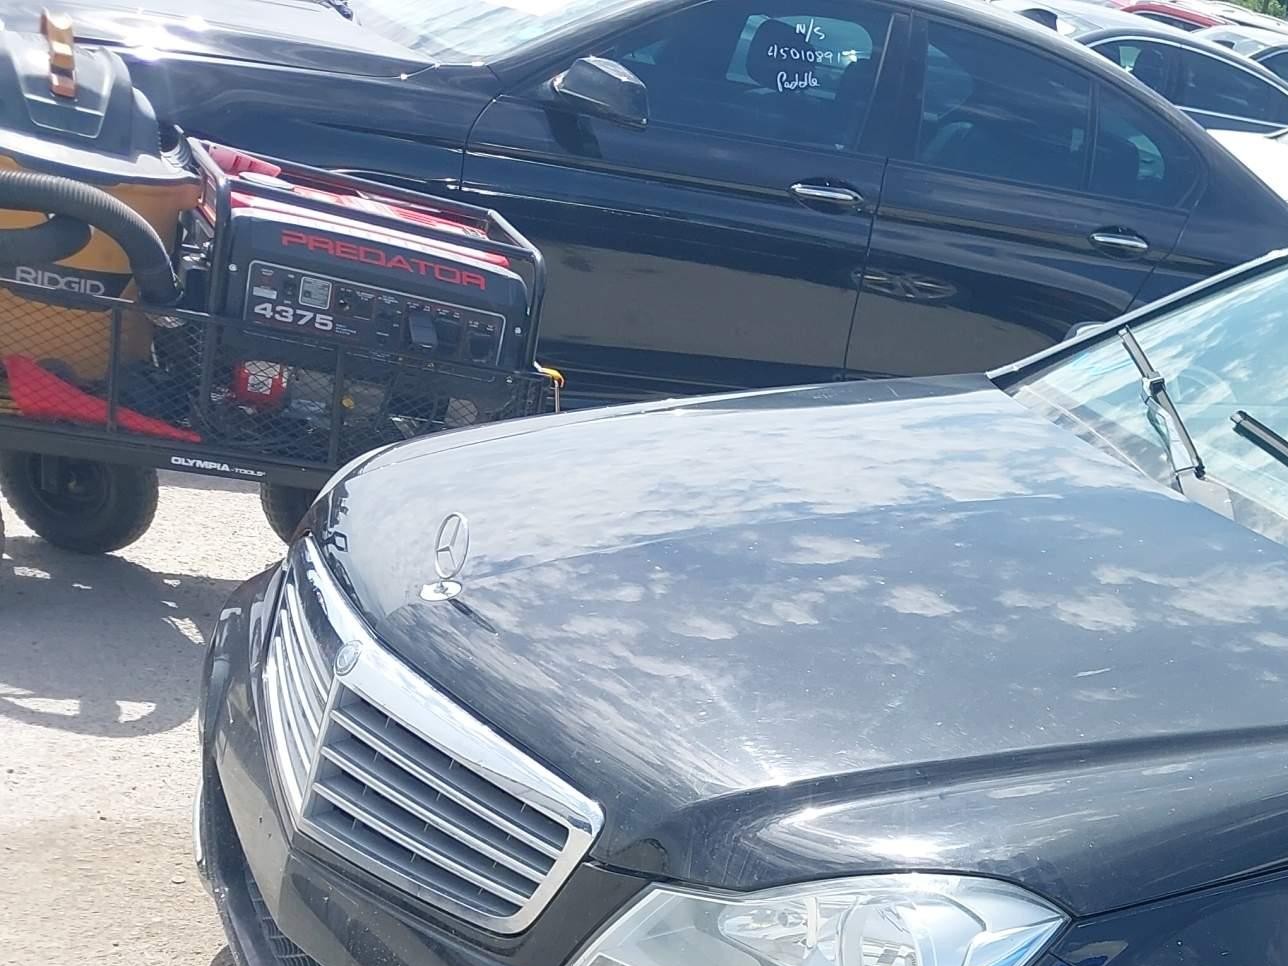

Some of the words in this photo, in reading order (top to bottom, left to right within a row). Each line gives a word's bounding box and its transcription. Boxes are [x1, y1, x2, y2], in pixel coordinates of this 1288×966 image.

[795, 18, 825, 42] N/S
[281, 230, 486, 290] PREDATOR
[16, 266, 105, 295] RIDGID
[254, 302, 334, 331] 4375
